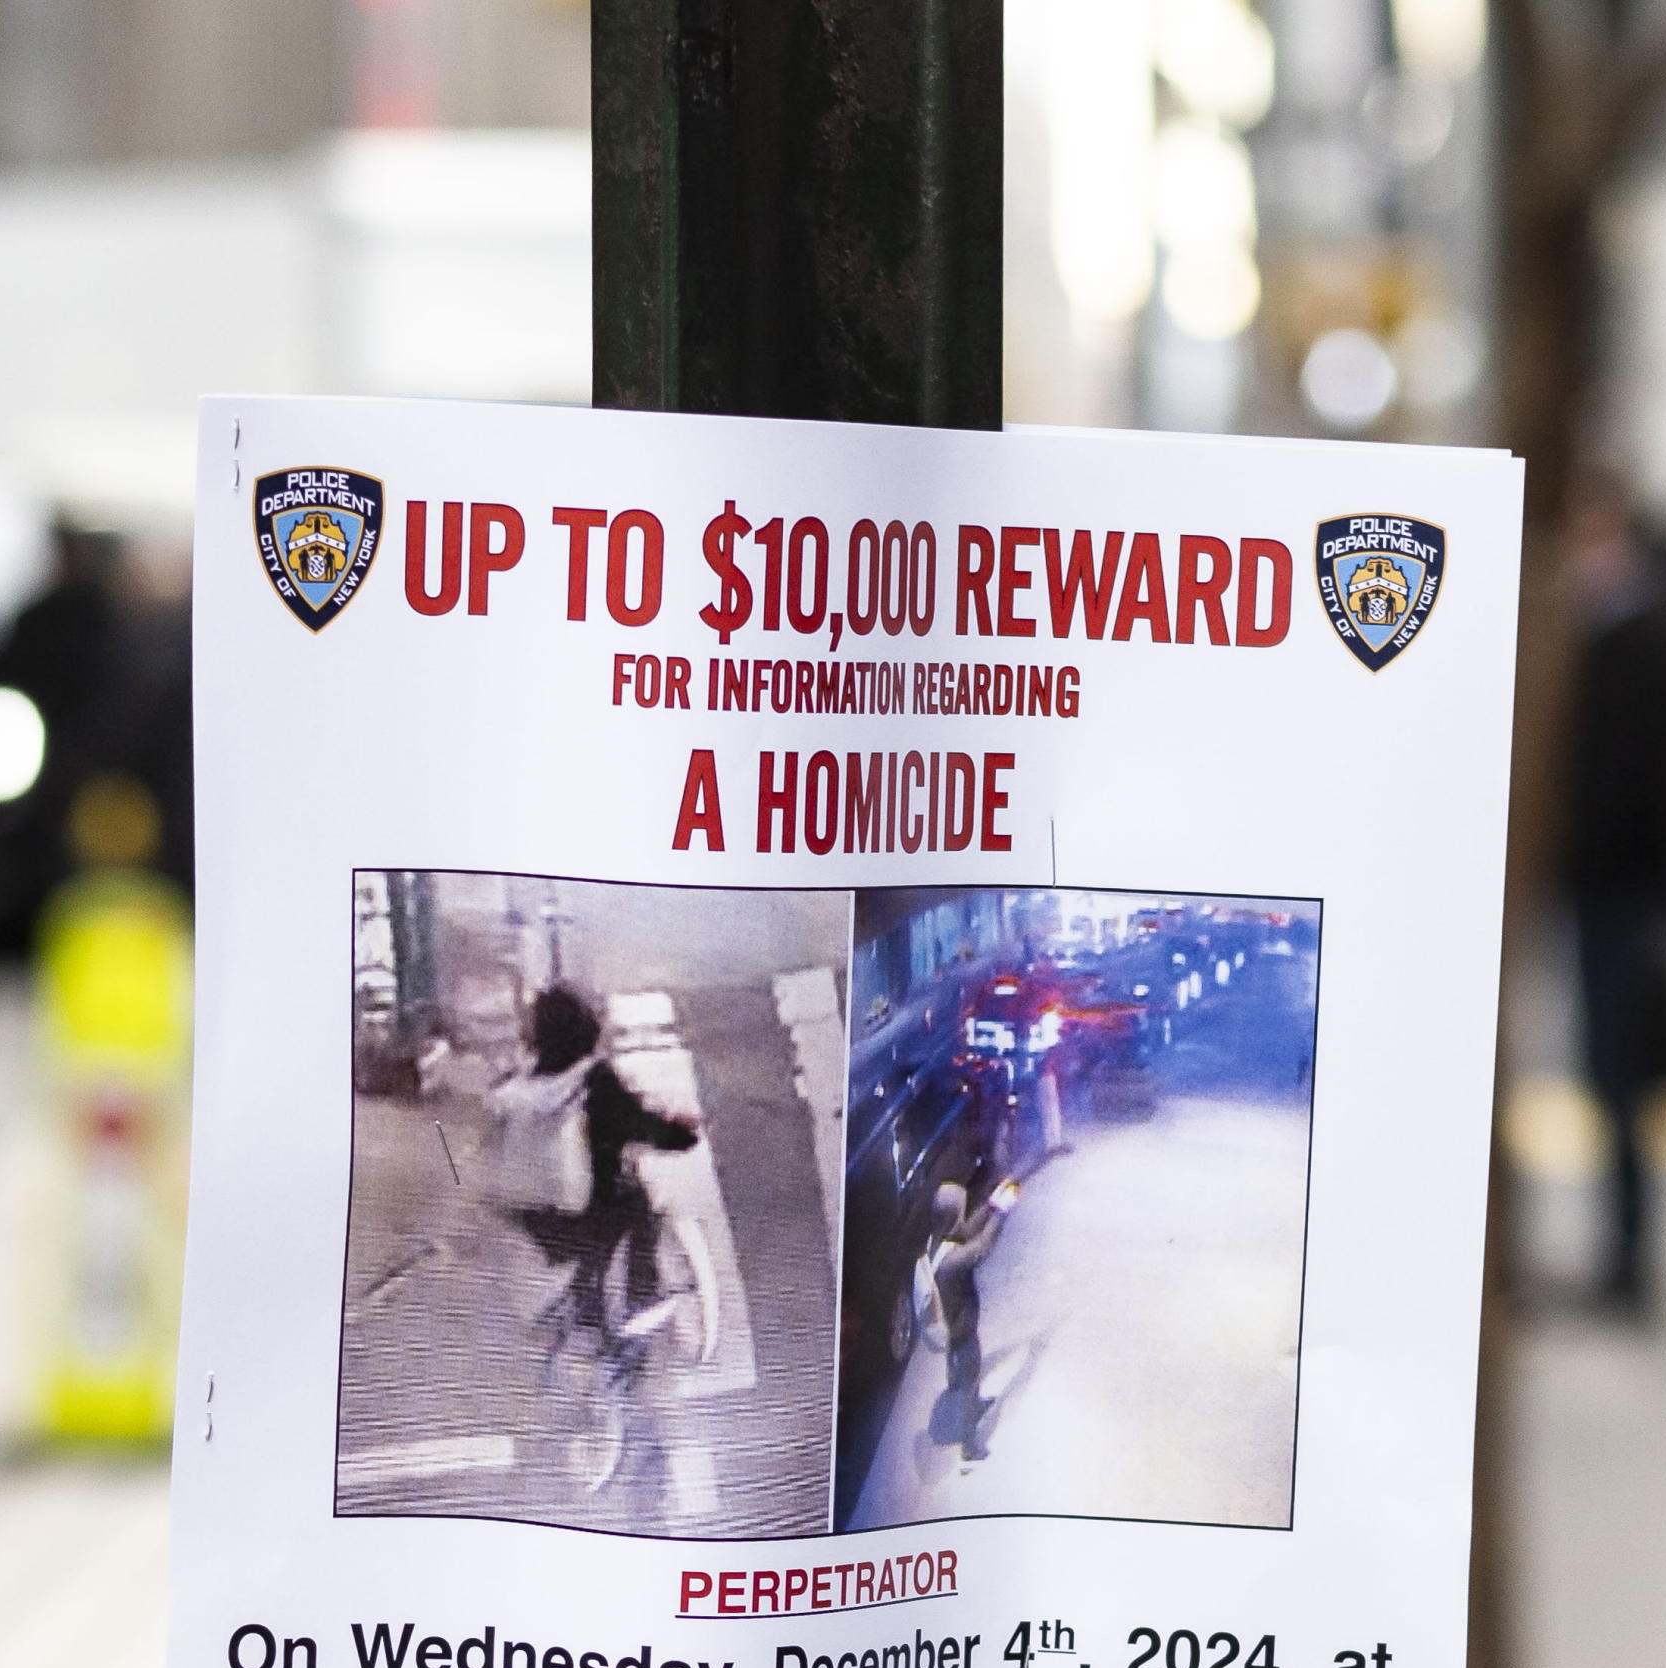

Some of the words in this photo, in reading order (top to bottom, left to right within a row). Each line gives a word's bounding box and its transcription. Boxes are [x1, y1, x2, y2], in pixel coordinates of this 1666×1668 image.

[261, 488, 376, 517] DEPARTMENT
[287, 471, 350, 490] POLICE
[1322, 534, 1438, 563] DEPARTMENT
[1349, 518, 1413, 537] POLICE
[260, 533, 282, 573] CITY
[276, 576, 297, 598] OF
[333, 571, 360, 606] NEW
[354, 528, 376, 569] YORK
[405, 500, 525, 616] UP
[552, 506, 664, 627] TO
[699, 500, 936, 652] $10,000
[955, 524, 1293, 648] REWARD
[1320, 576, 1342, 614] CITY
[1335, 618, 1356, 639] OF
[1392, 615, 1421, 648] NEW
[1415, 575, 1438, 613] YORK
[612, 653, 691, 710] FOR
[708, 658, 906, 715] INFORMATION
[913, 662, 1080, 718] REGARDING
[672, 749, 725, 852] A
[756, 750, 1015, 855] HOMICIDE
[675, 1550, 958, 1619] PERPETRATOR
